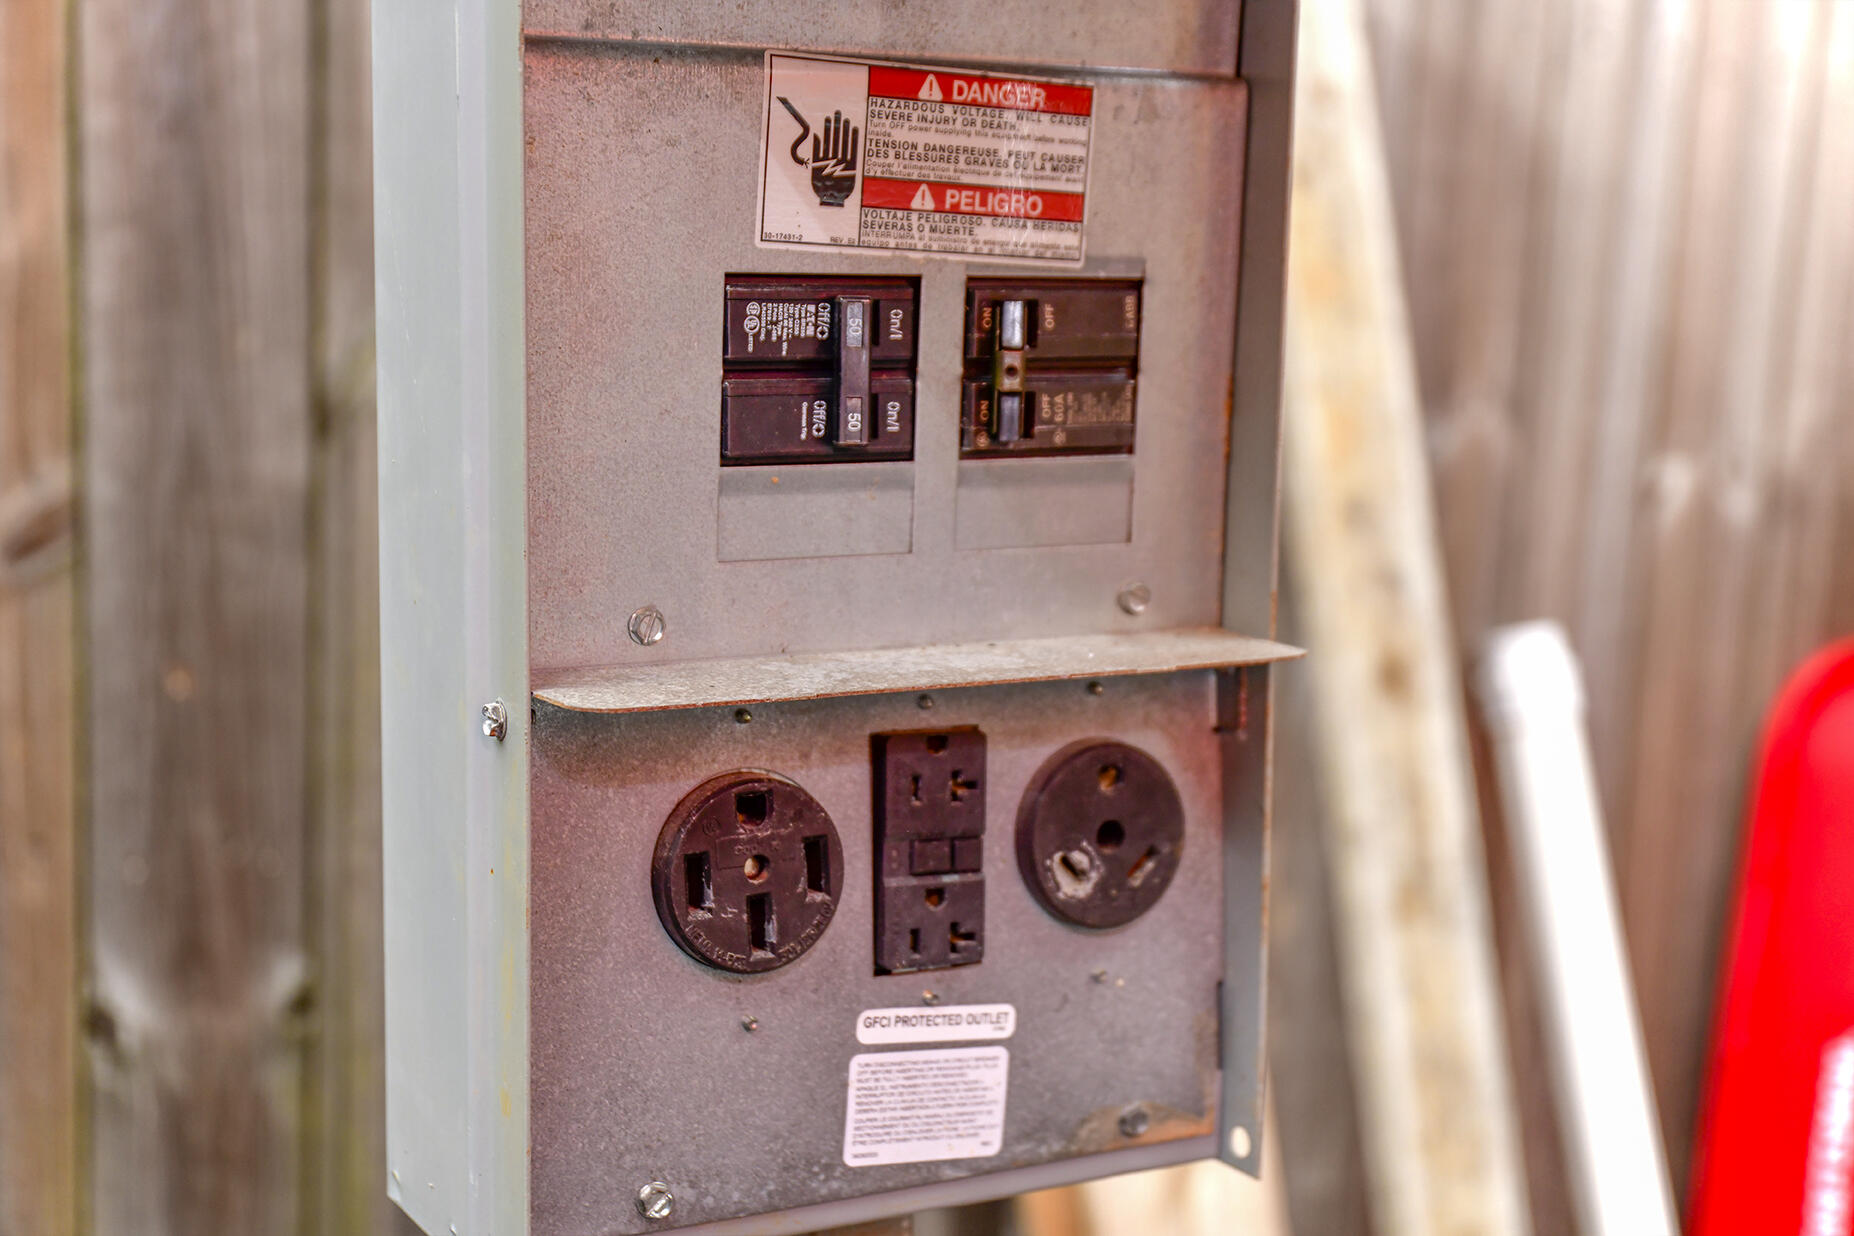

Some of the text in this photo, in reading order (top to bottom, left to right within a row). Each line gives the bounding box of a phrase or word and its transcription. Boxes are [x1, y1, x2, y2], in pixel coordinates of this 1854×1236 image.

[952, 79, 1047, 108] DANGER
[869, 109, 1020, 131] SEVERE INJURY OR DEATH.
[870, 98, 945, 113] HAZARDOUS
[1016, 110, 1042, 123] WILL
[1050, 114, 1089, 126] CAUSE
[869, 119, 886, 128] Turn
[889, 121, 905, 129] OFF
[908, 124, 932, 133] power
[935, 126, 971, 138] supplying
[867, 148, 1082, 173] DES BLESSURES GRAVES OU LA MORT
[868, 138, 918, 151] TENSION
[1008, 150, 1036, 160] PEUT
[1041, 152, 1085, 165] CAUSER
[866, 158, 895, 169] Couper
[945, 189, 1043, 217] PELIGRO
[862, 219, 978, 237] SEVERAS O MUERTE.
[863, 208, 912, 222] VOLTAJE
[991, 217, 1028, 230] CAUSA
[1033, 219, 1080, 233] HERIDAS
[862, 229, 915, 241] INTERRUMPA
[982, 307, 992, 329] ON
[1044, 303, 1054, 329] OFF
[848, 318, 862, 337] 50
[980, 400, 989, 421] ON
[1041, 393, 1050, 418] OFF
[1053, 393, 1065, 421] 60A
[848, 412, 861, 432] 50
[863, 1011, 1010, 1029] GFCI PROTECTED OUTLET
